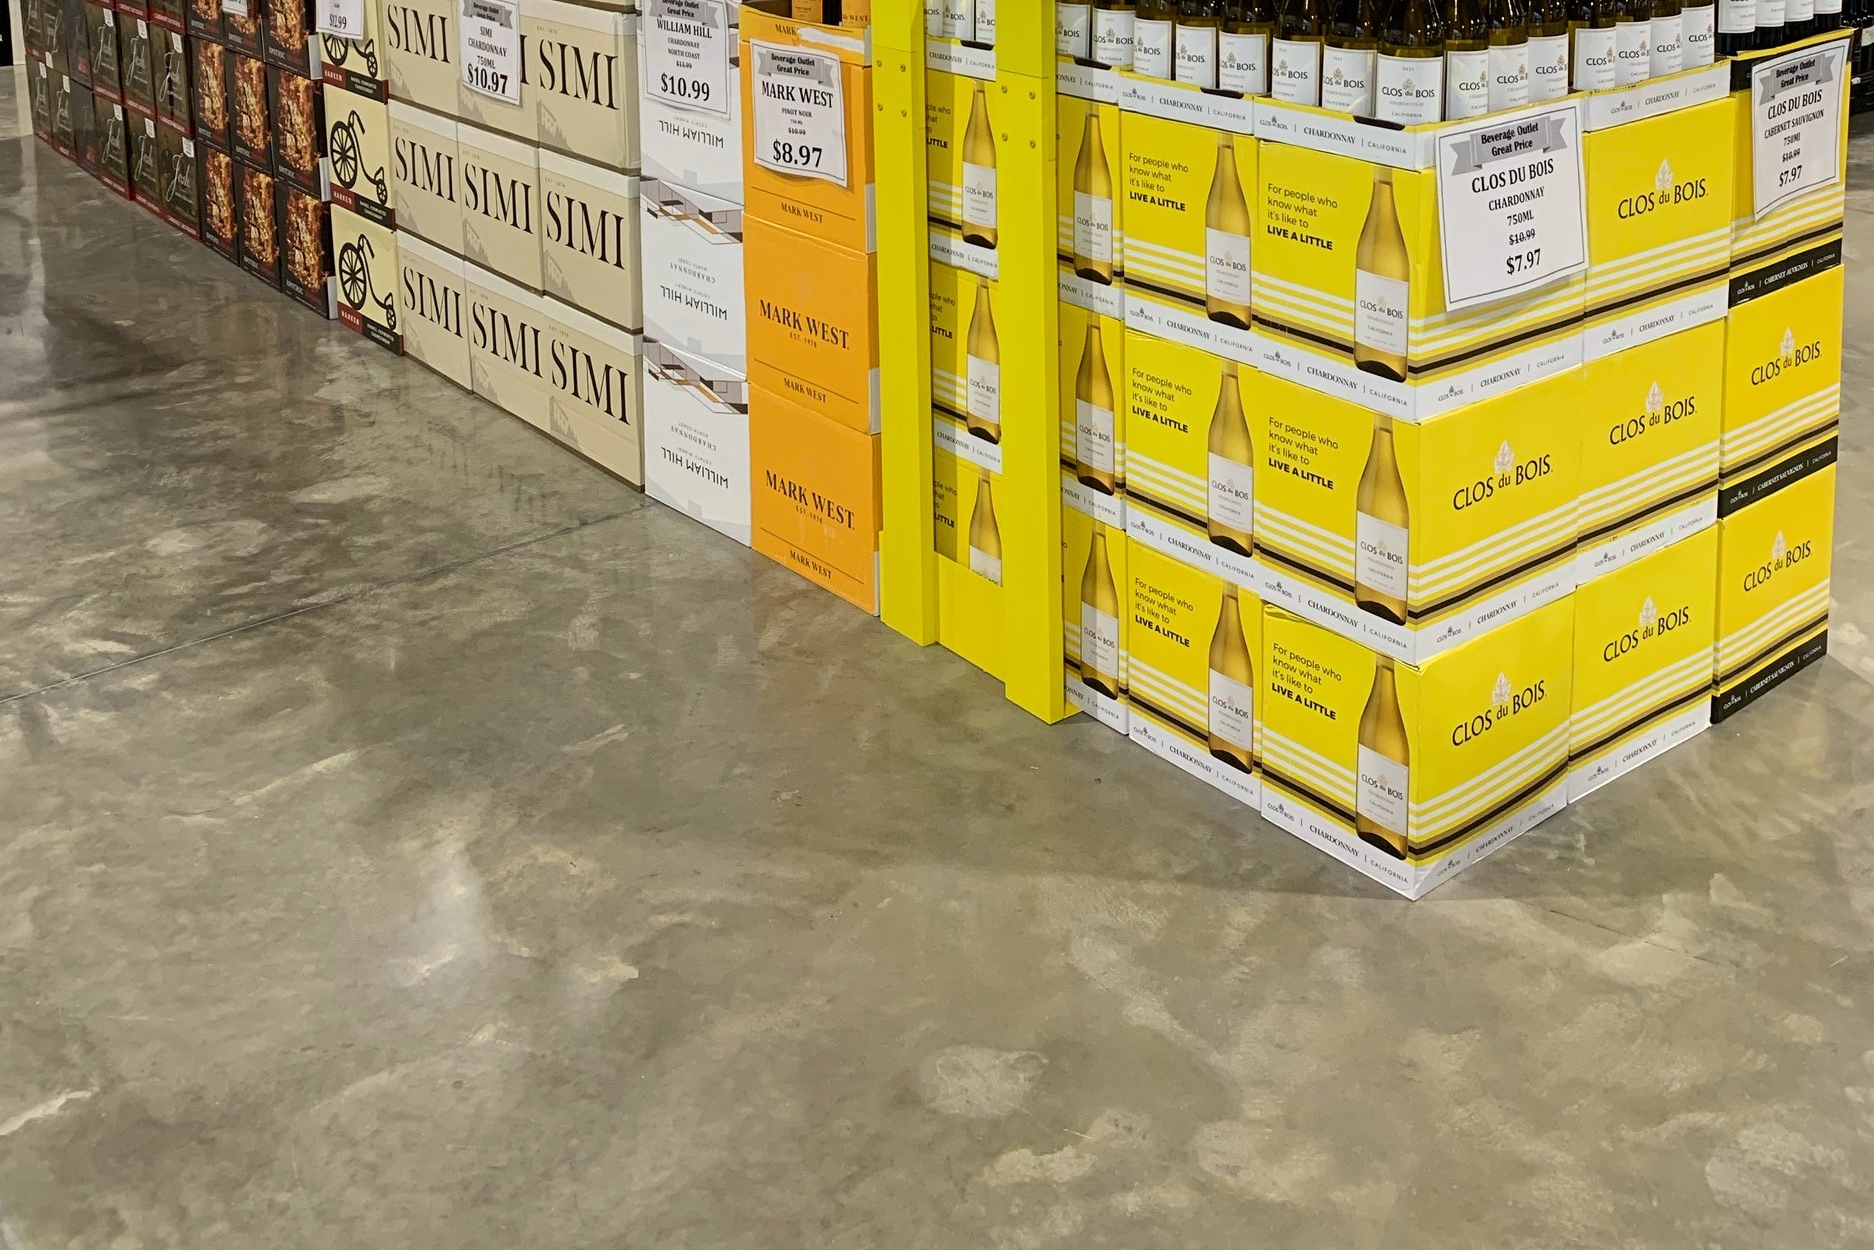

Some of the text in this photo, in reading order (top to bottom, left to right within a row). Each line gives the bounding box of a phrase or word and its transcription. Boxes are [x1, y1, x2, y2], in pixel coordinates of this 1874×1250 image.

[667, 7, 694, 18] Great Price
[684, 1, 699, 9] Outlet
[329, 14, 347, 29] $12.99
[480, 26, 492, 38] SIMI
[657, 18, 712, 39] WILLIAM HILL
[776, 24, 797, 36] MARK
[388, 4, 450, 64] SIMI
[668, 37, 700, 48] CHARDONNAY
[468, 37, 507, 57] CHARDONNAY
[668, 48, 700, 60] NORTH COAST
[1618, 49, 1640, 59] CLOS
[477, 55, 496, 69] 750ML
[771, 53, 815, 66] Beverage Outlet
[1776, 59, 1815, 78] Beverage Outlet
[468, 63, 508, 95] $10.97
[539, 39, 619, 110] SIMI
[777, 65, 809, 76] Great Price
[1781, 73, 1809, 88] Great Price
[661, 72, 710, 101] $10.99
[762, 80, 833, 108] MARK WEST
[1382, 86, 1403, 98] CLOS
[782, 107, 812, 118] PINOT NOIR
[1768, 89, 1822, 120] CLOS DU BOIS
[1481, 123, 1539, 144] Beverage Outlet
[1764, 109, 1824, 139] CABERNET SAUVIGNON
[1304, 127, 1356, 144] CHARDONNAY
[1368, 141, 1407, 154] CALIFORNIA
[1491, 139, 1533, 157] Great Price
[773, 138, 822, 168] $8.97
[1472, 158, 1554, 193] CLOS DU BOIS
[1779, 165, 1802, 187] $7.97
[1268, 183, 1338, 208] For people who
[1488, 186, 1545, 211] CHARDONNAY
[1617, 192, 1655, 220] CLOS
[1659, 191, 1670, 205] du
[1268, 196, 1317, 217] know what
[1282, 214, 1297, 225] like
[1300, 219, 1309, 228] to
[1507, 210, 1534, 226] 750ML
[546, 190, 626, 271] SIMI
[1267, 225, 1333, 250] LIVE A LITTLE
[1509, 228, 1536, 245] $10.99
[1506, 249, 1541, 275] $7.97
[760, 299, 802, 332] MARK
[472, 301, 544, 379] SIMI
[1751, 357, 1781, 387] CLOS
[1783, 352, 1793, 369] du
[551, 338, 631, 426] SIMI
[784, 378, 826, 403] MARK WEST
[1453, 477, 1494, 511] CLOS
[1498, 473, 1511, 489] du
